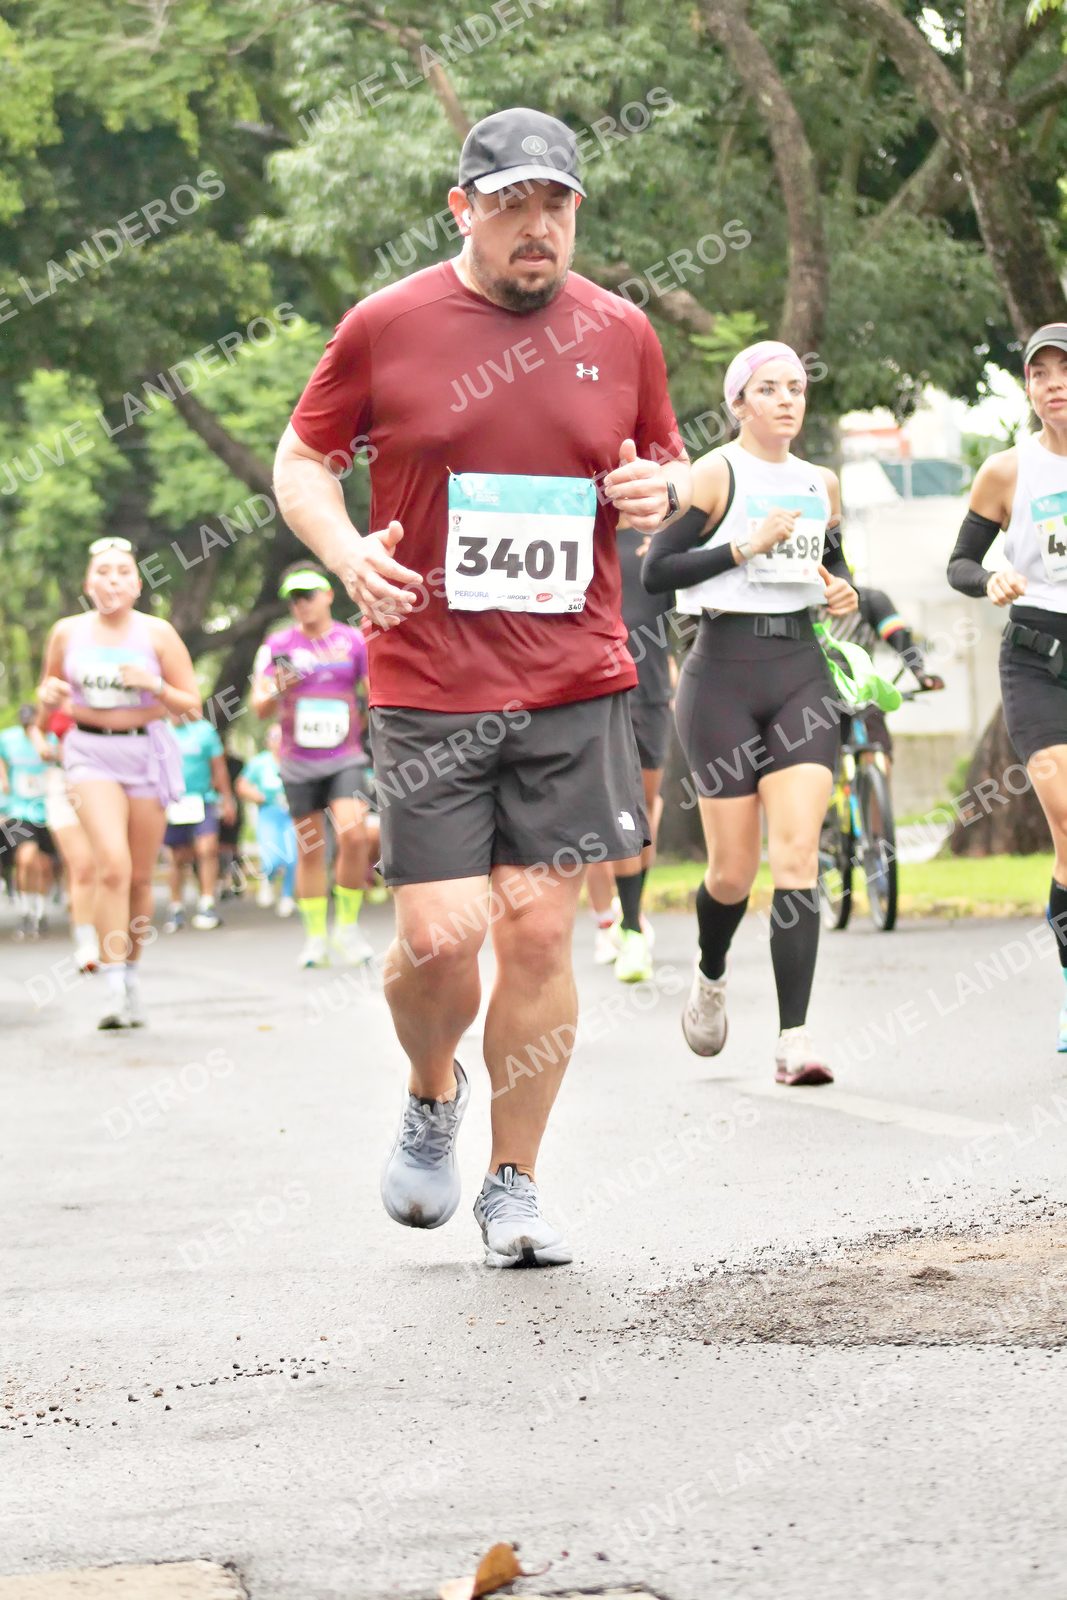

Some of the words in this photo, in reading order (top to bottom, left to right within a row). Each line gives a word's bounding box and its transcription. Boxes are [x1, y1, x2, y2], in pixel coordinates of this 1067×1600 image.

[456, 536, 578, 581] 3401
[766, 535, 820, 560] 498
[454, 590, 490, 598] PERDURA
